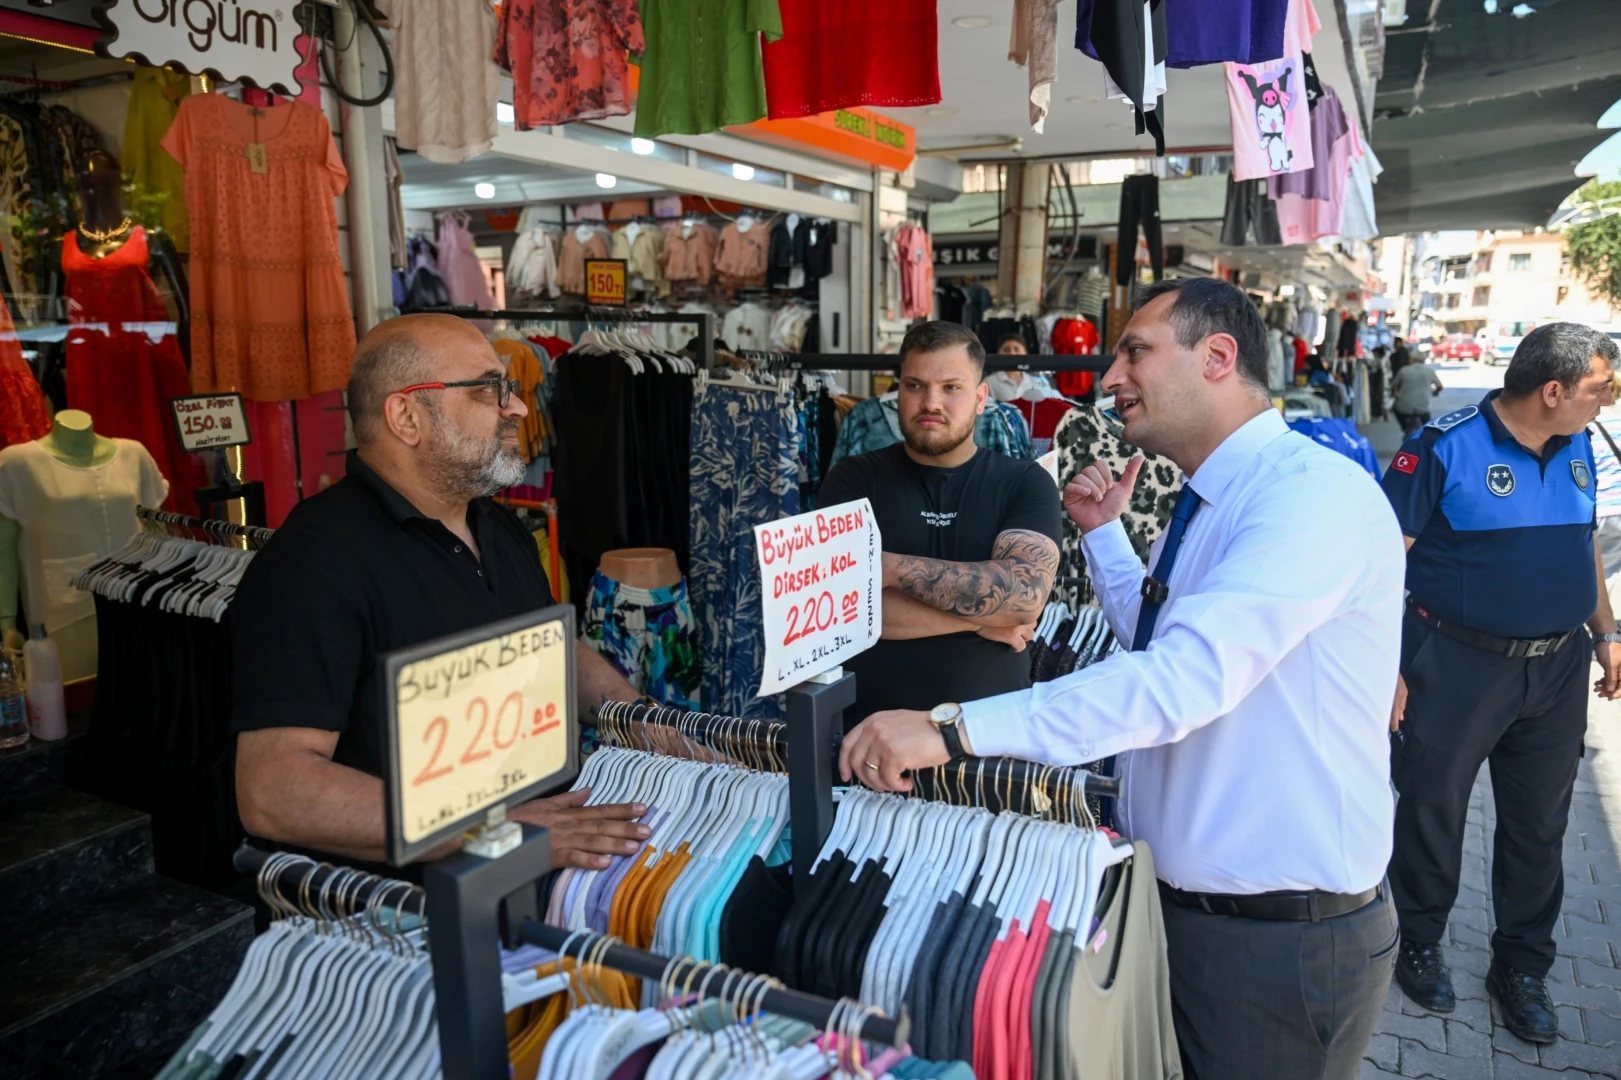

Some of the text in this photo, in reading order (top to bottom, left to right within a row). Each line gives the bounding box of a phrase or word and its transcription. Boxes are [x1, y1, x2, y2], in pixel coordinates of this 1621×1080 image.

[590, 273, 613, 293] 150
[761, 509, 864, 565] BÜYÜK BEDEN
[831, 551, 857, 577] KOL
[498, 626, 564, 668] BEDEN
